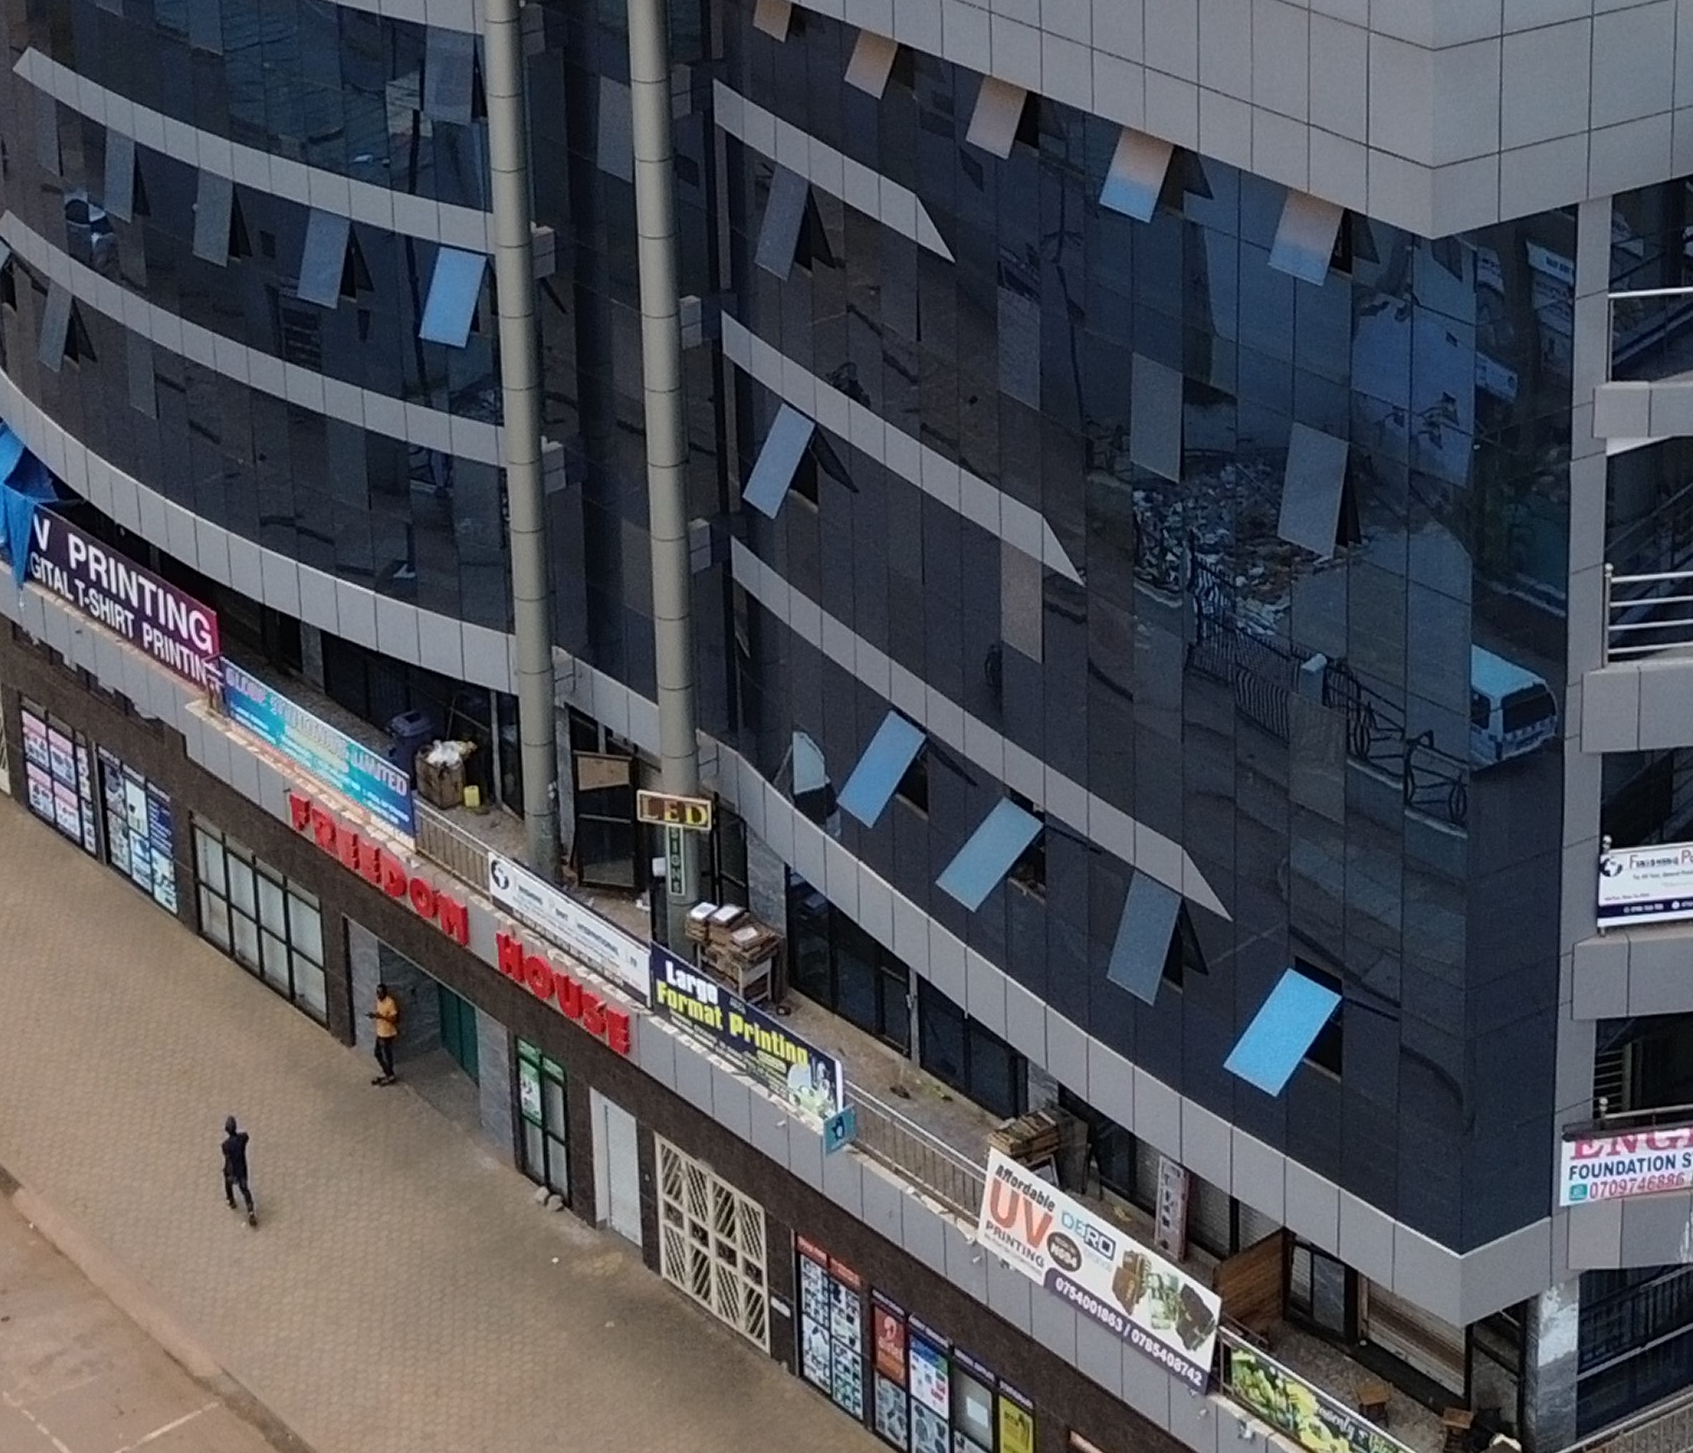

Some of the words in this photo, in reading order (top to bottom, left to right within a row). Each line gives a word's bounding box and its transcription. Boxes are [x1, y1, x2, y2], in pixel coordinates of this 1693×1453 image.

[67, 532, 214, 655] PRINTING
[74, 578, 135, 640] T-SHIRT
[141, 621, 221, 693] PRINTIN
[641, 794, 709, 825] LED
[289, 791, 470, 946] FREEDOM
[495, 931, 632, 1054] HOUSE
[665, 959, 719, 1005] Large
[656, 979, 724, 1032] Format
[728, 1011, 809, 1066] Printing
[994, 1163, 1056, 1213] Affordable
[1568, 1157, 1675, 1181] FOUNDATION
[989, 1178, 1054, 1249] UV
[1060, 1208, 1117, 1262] DERO
[985, 1219, 1046, 1269] PRINTING
